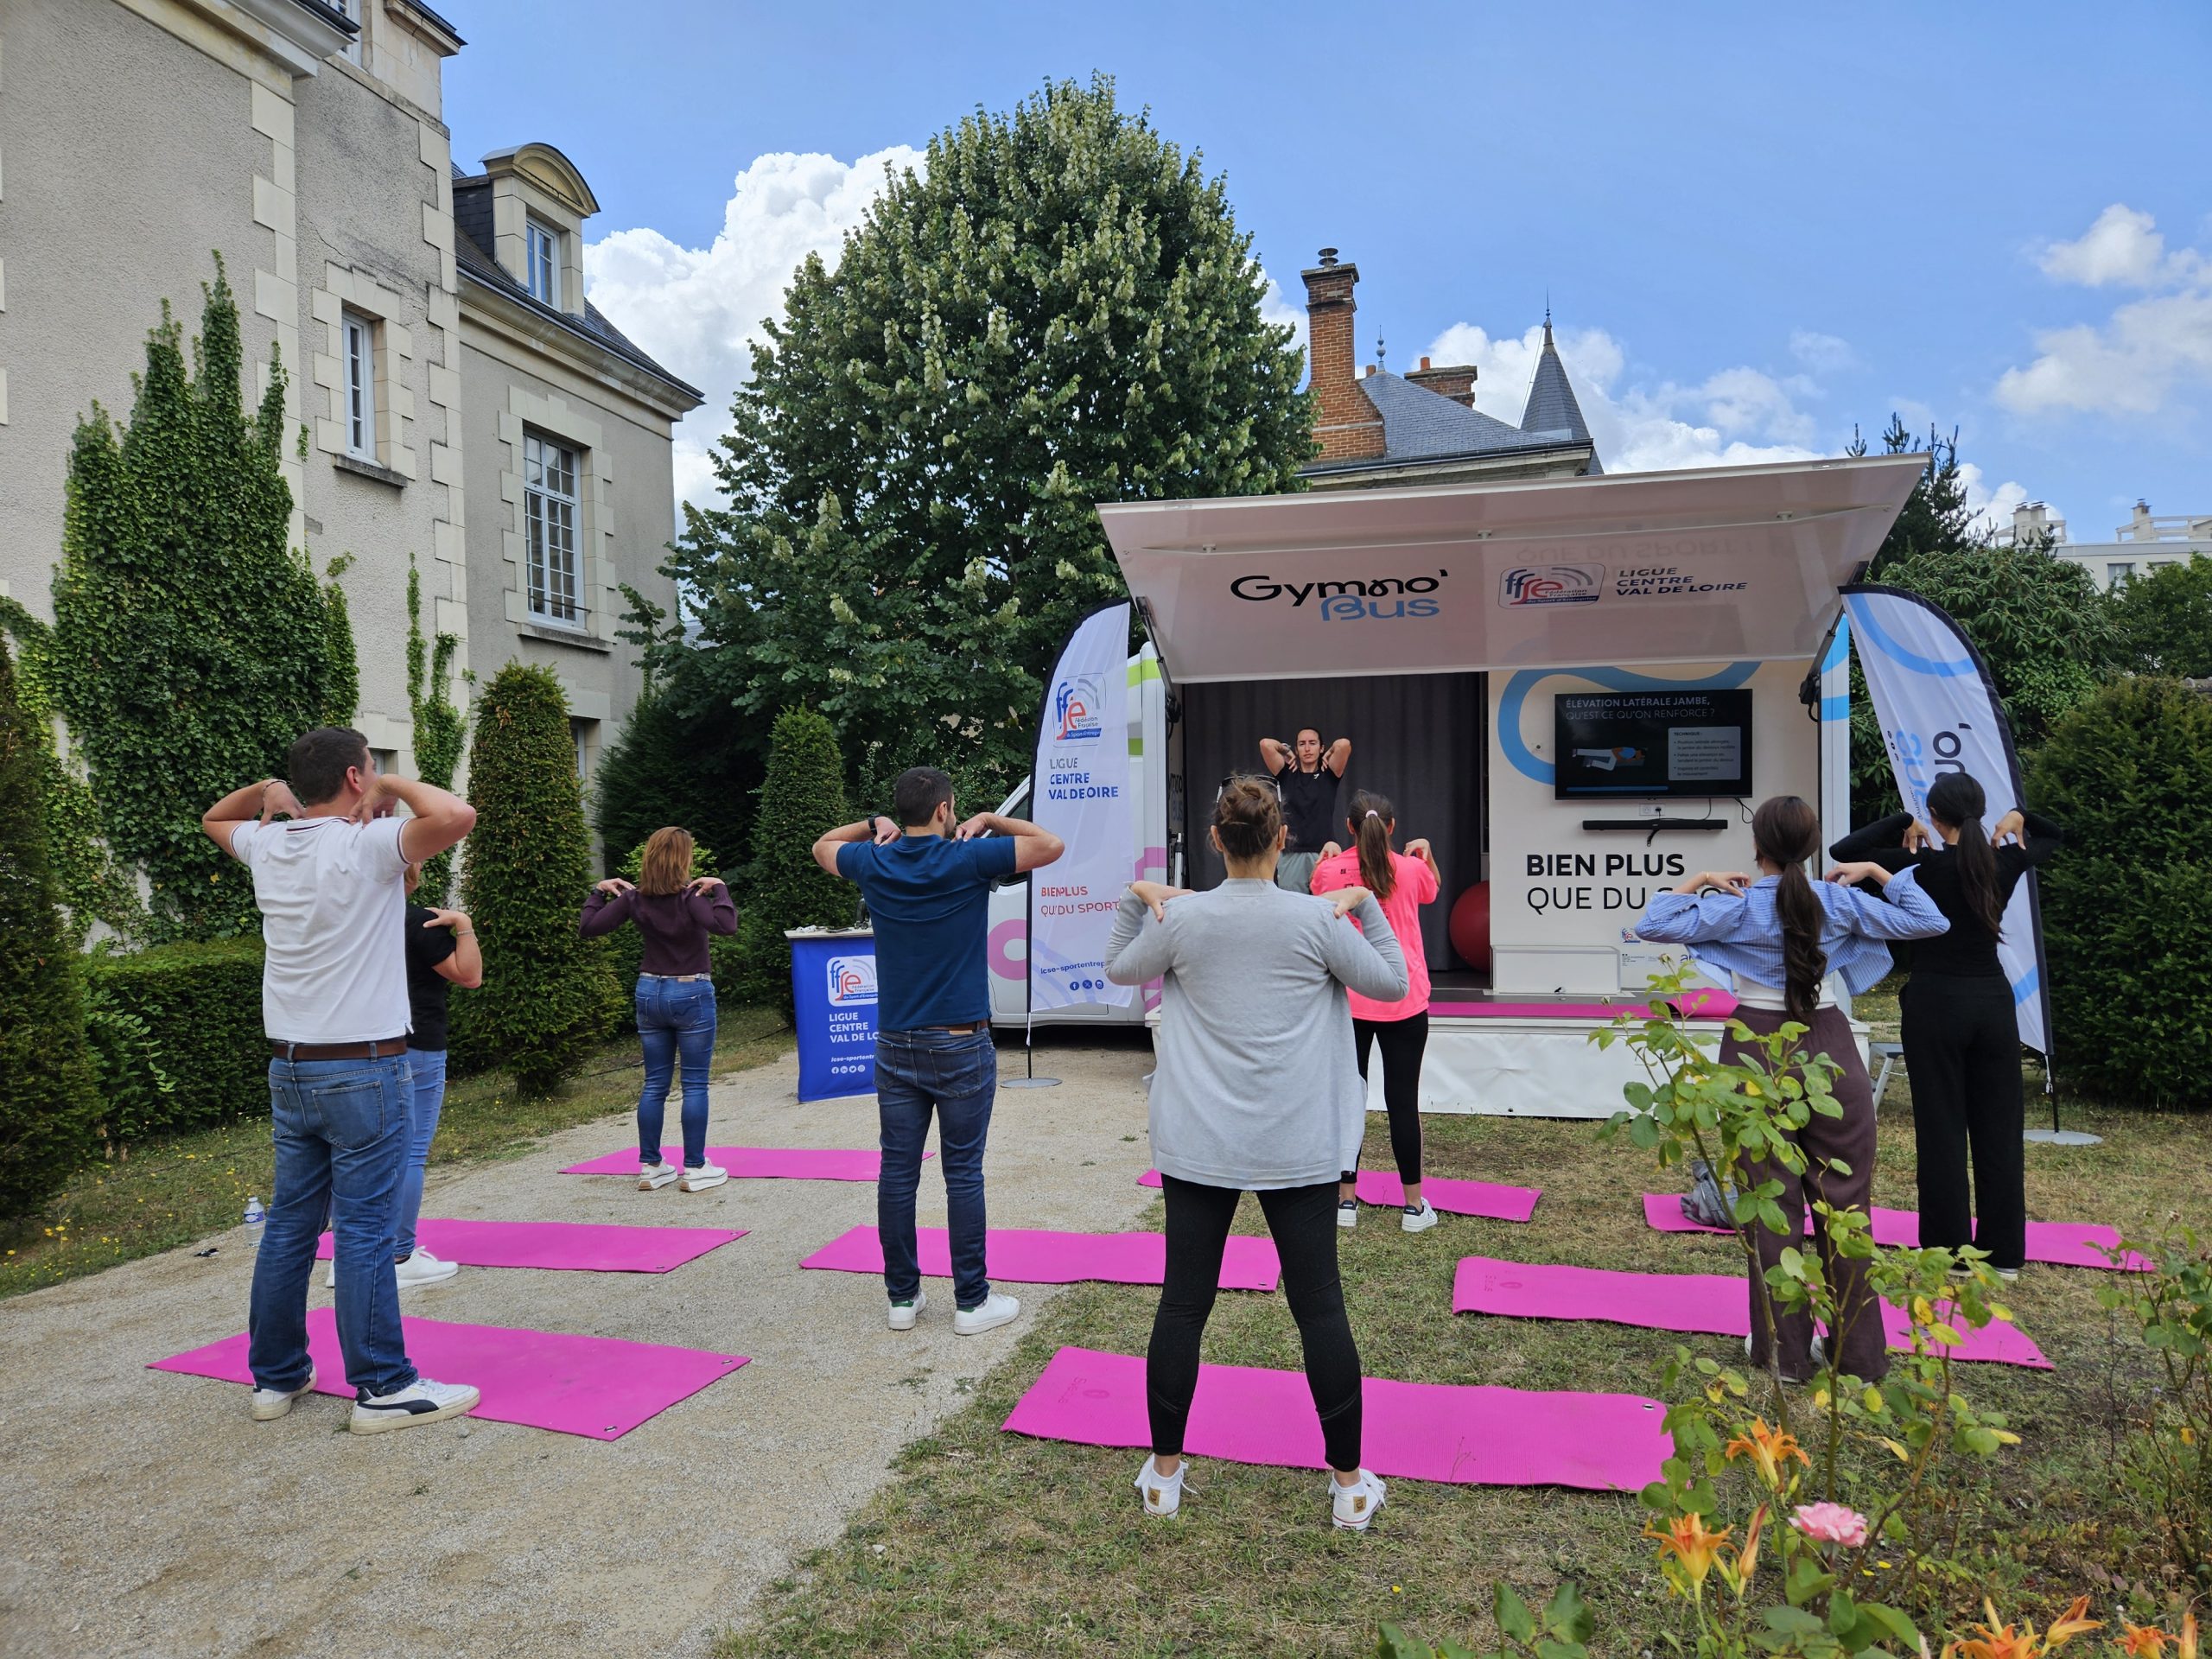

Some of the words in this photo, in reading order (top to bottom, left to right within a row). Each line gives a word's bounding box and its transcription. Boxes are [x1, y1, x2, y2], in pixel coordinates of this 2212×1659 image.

[1619, 567, 1677, 577] LIGUE
[1617, 575, 1694, 587] CENTRE
[1617, 586, 1652, 596] VAL
[1658, 584, 1686, 594] DE
[1688, 582, 1748, 593] LOIRE
[1320, 594, 1440, 621] Bus
[1623, 696, 1671, 707] LATÉRALE
[1673, 696, 1710, 707] JAMBE,
[1617, 709, 1651, 720] QU'ON
[1654, 709, 1707, 719] RENFORCE
[1049, 758, 1077, 769] LIGUE
[1050, 772, 1090, 785] CENTRE
[1048, 789, 1067, 799] VAL
[1070, 788, 1084, 799] DE
[1085, 786, 1118, 798] OIRE
[1527, 855, 1595, 876] BIEN
[1605, 854, 1685, 876] PLUS
[1528, 887, 1592, 915] QUE
[1604, 887, 1646, 910] DU
[829, 1012, 858, 1022] LIGUE
[829, 1021, 868, 1033] CENTRE
[830, 1033, 849, 1043] VAL
[851, 1032, 864, 1041] DE
